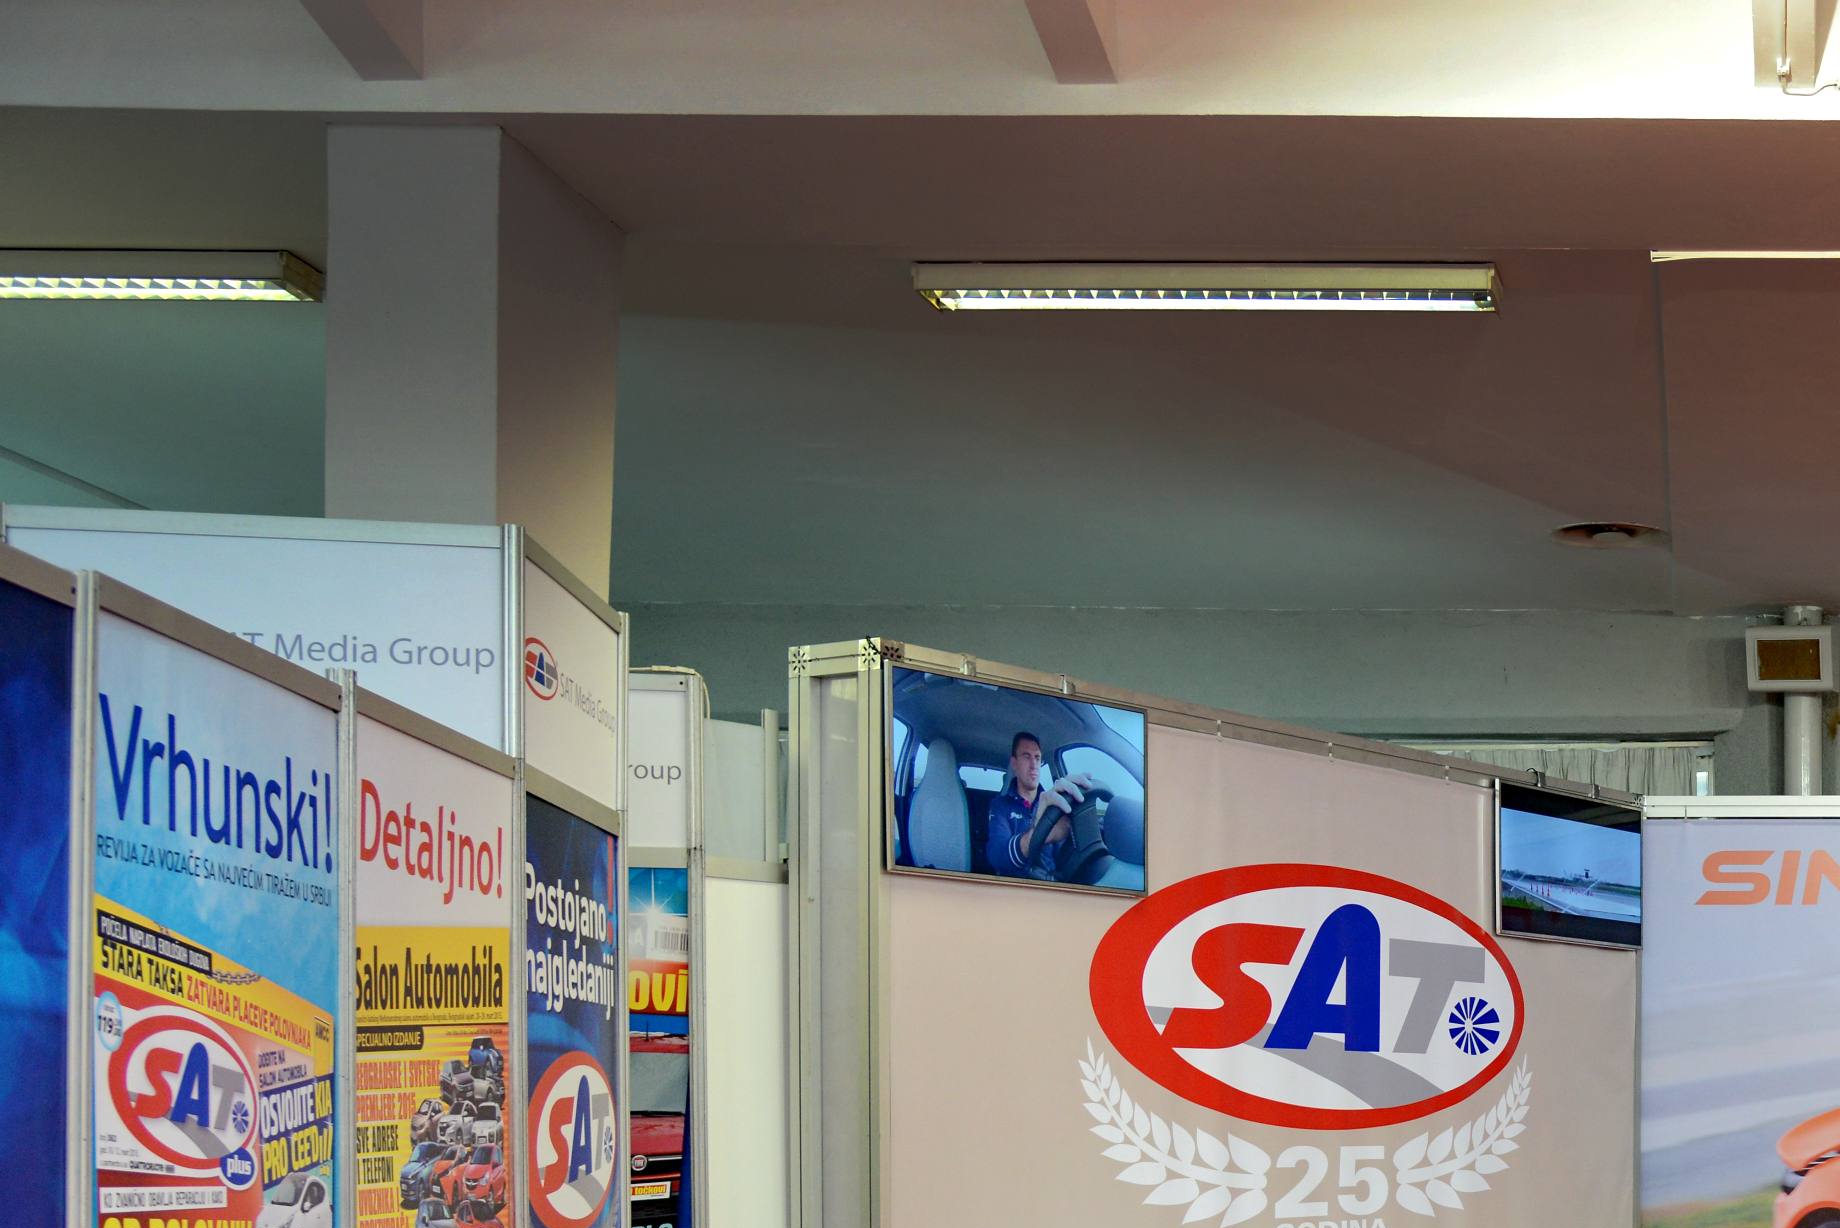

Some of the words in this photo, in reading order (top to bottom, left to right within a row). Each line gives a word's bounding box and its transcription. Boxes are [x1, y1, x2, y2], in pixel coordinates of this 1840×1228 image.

[274, 633, 378, 664] Media
[389, 637, 495, 675] Group
[99, 693, 333, 873] Vrhunski!
[629, 764, 682, 785] oup
[96, 834, 138, 864] REVIJA
[141, 844, 156, 867] ZA
[158, 847, 200, 877] VOZAČE
[203, 858, 216, 878] SA
[218, 864, 263, 889] NAJVEĆIM
[266, 873, 300, 899] TIRAŽEM
[302, 884, 309, 901] U
[360, 778, 503, 904] Detaljno!
[526, 861, 607, 950] Postojano
[101, 938, 144, 982] STARA
[147, 957, 184, 998] TAKSA
[186, 975, 231, 1017] ZATVARA
[356, 945, 400, 1011] Salon
[403, 945, 503, 1010] Automobila
[526, 937, 615, 1021] najgledaniji
[1162, 903, 1486, 1054] SAT
[132, 1041, 245, 1132] SAT
[261, 1083, 315, 1139] OSVOJITE
[314, 1079, 333, 1119] KIA
[226, 1154, 252, 1178] plus
[263, 1137, 289, 1184] PRO
[545, 1074, 609, 1195] SAT
[1275, 1145, 1389, 1219] 25
